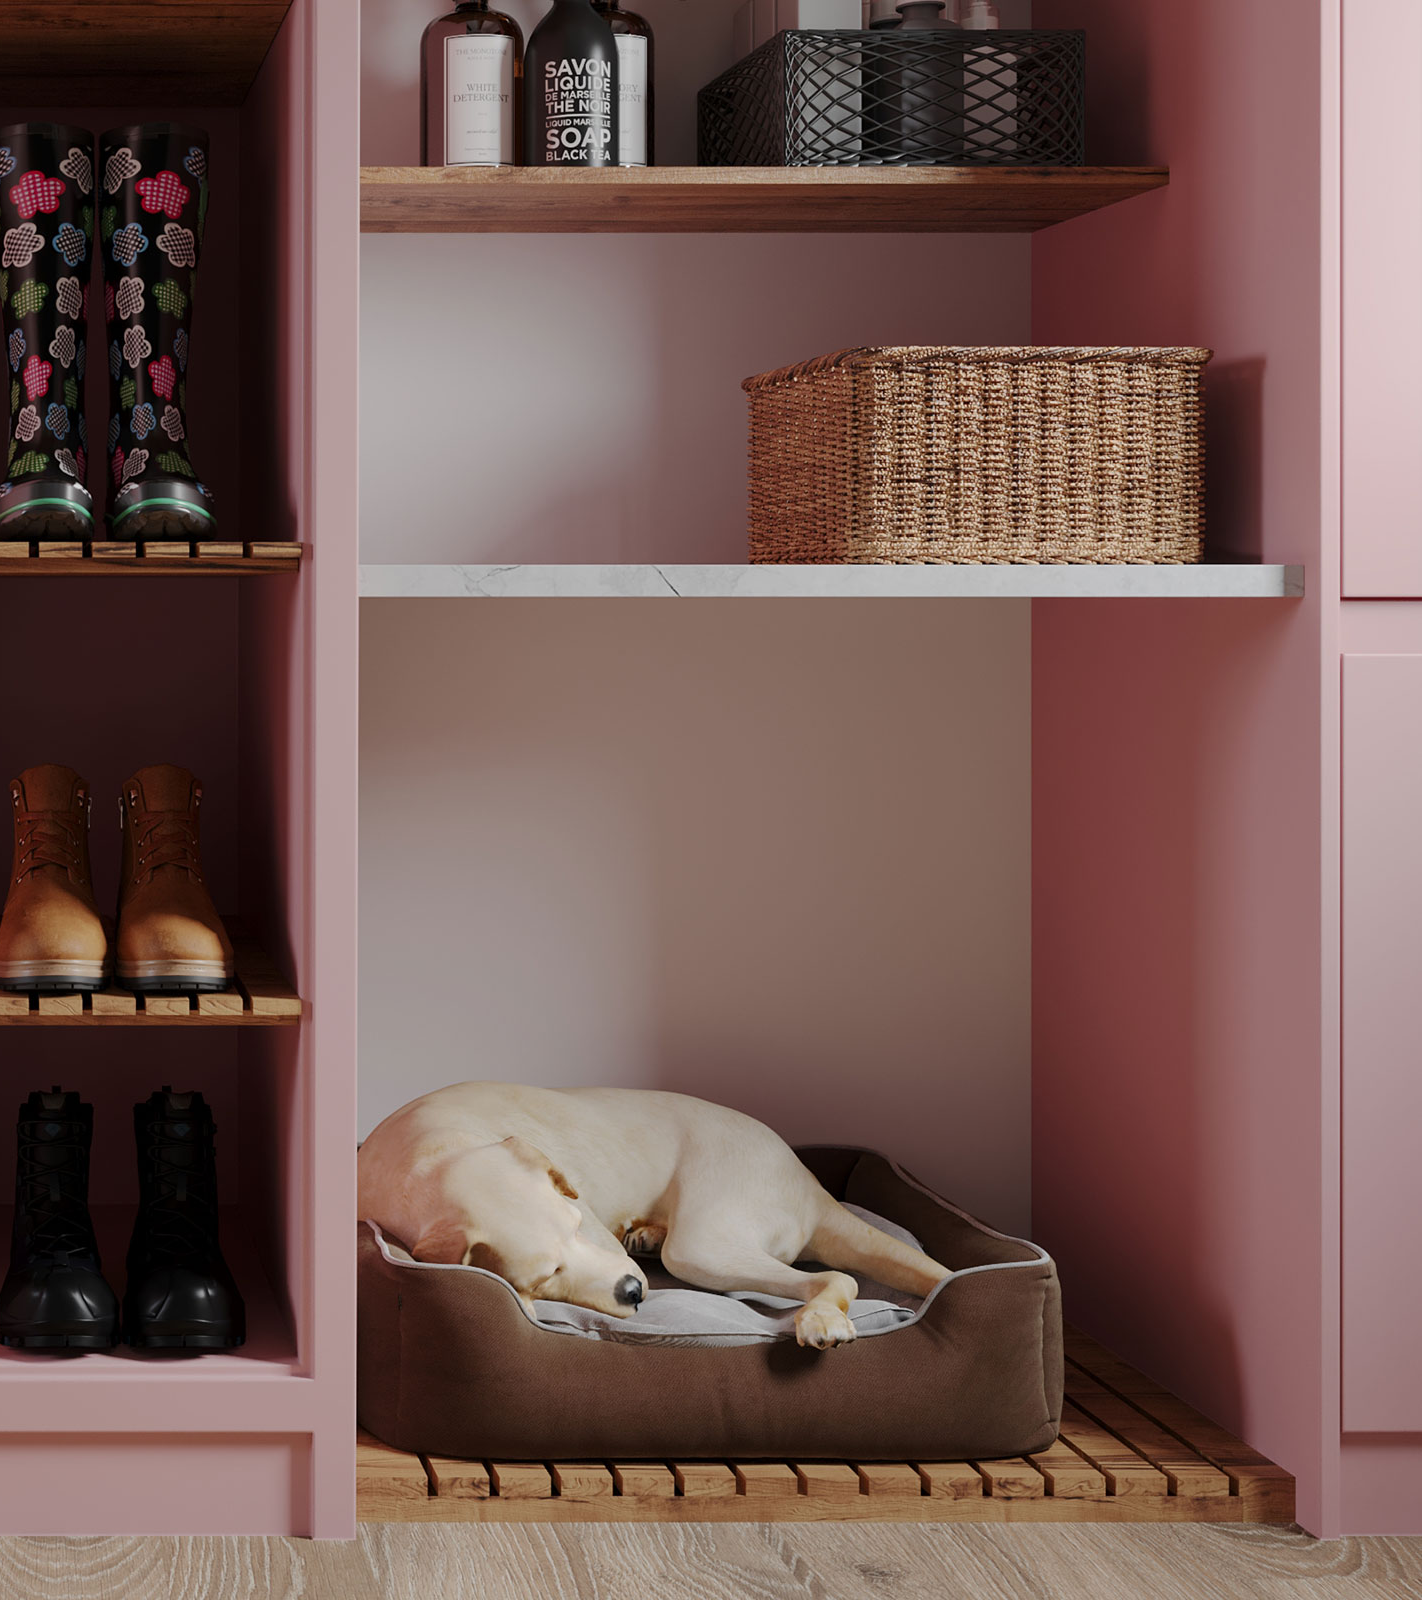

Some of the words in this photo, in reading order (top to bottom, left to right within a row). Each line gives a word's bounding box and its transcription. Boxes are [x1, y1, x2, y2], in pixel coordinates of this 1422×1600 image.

[545, 58, 611, 79] SAVON
[466, 83, 498, 92] WHITE
[545, 76, 611, 93] LIQUIDE
[453, 93, 509, 103] DETERGENT
[545, 92, 558, 102] DE
[579, 99, 611, 115] NOIR
[546, 119, 572, 129] LIQUID
[546, 127, 611, 149] SOAP
[546, 149, 587, 162] BLACK
[590, 150, 611, 161] TEA
